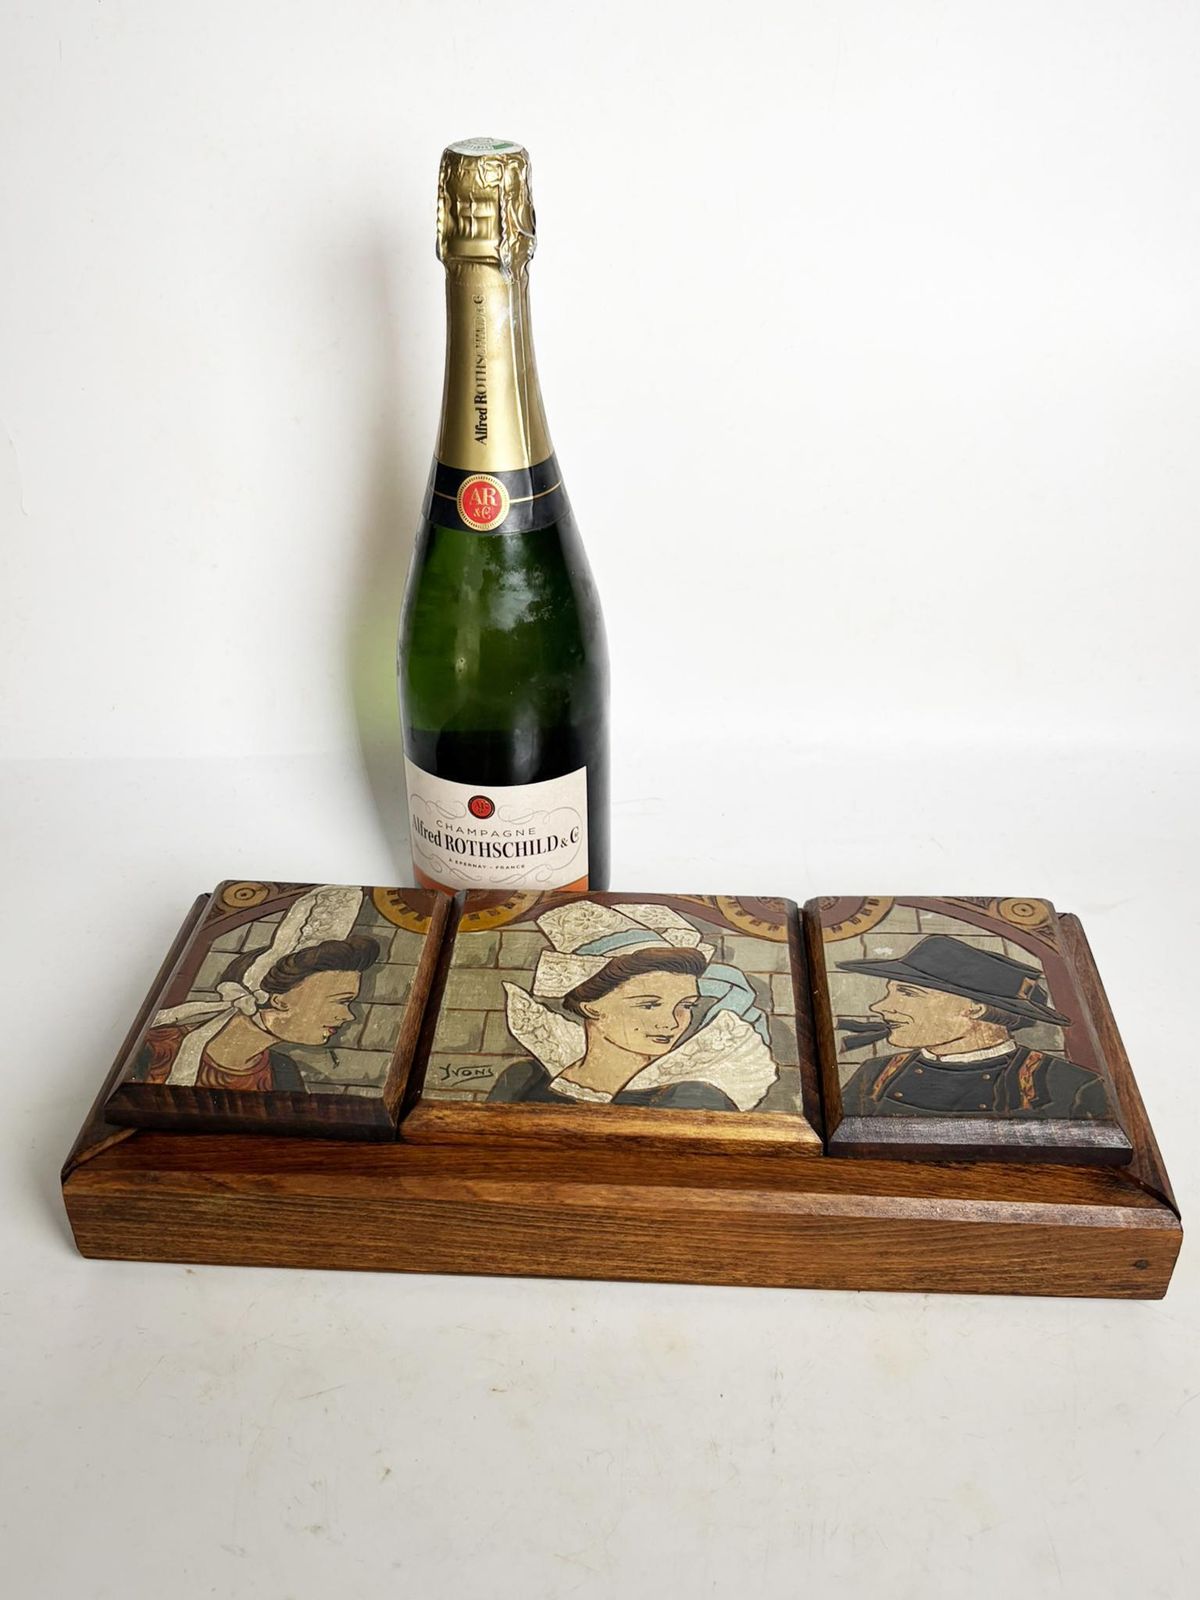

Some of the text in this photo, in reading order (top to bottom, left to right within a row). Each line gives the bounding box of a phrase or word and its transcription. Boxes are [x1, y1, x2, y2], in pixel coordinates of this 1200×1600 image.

[473, 315, 487, 405] ROTHSHIL
[474, 407, 487, 445] Alfred
[469, 487, 498, 507] AR
[412, 814, 442, 848] Alfred
[444, 834, 559, 859] ROTHSCHILD
[560, 837, 569, 848] &
[436, 819, 537, 838] CHAMPAGNE
